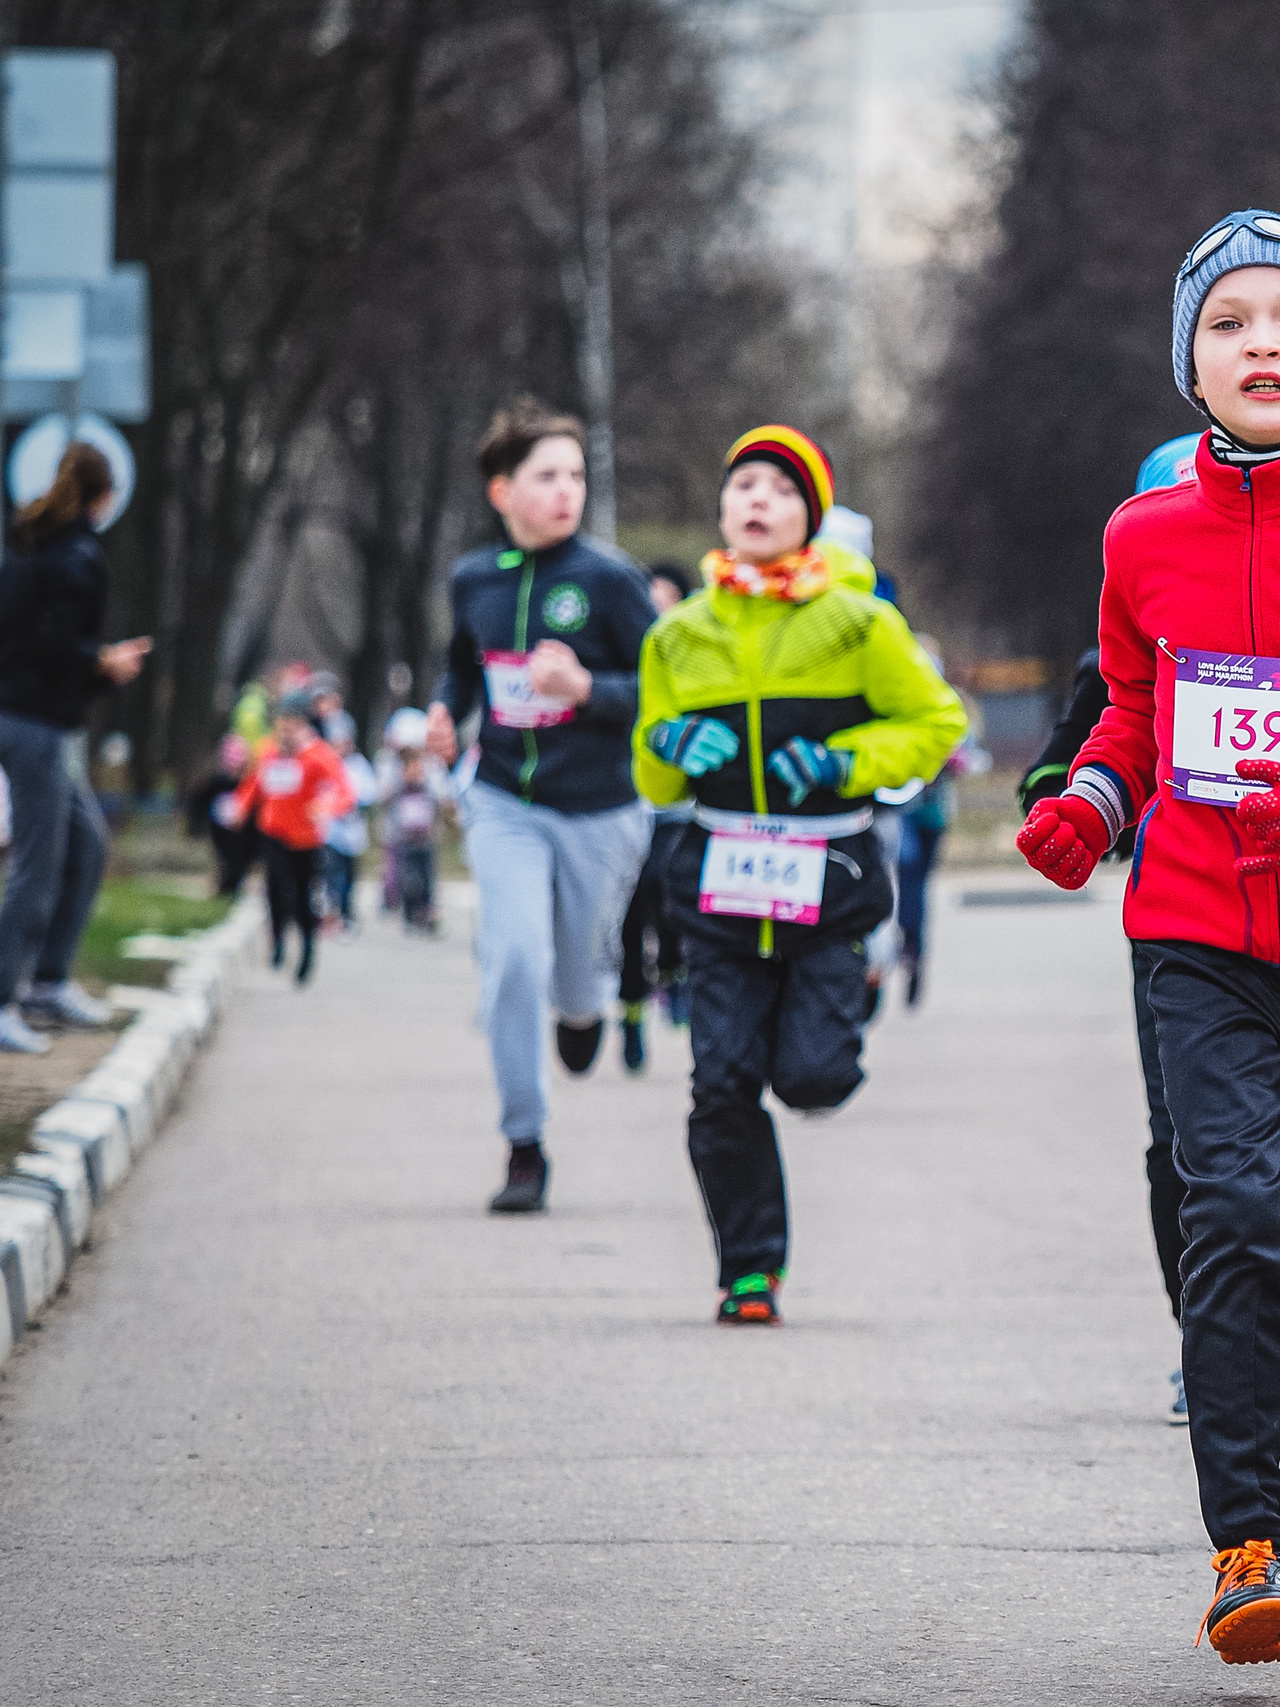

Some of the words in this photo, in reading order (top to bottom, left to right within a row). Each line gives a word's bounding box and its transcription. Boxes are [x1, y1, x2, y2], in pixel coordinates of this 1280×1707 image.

[1198, 661, 1215, 671] LOVE
[1215, 664, 1230, 672] AND
[1230, 665, 1255, 675] SPACE
[1197, 669, 1215, 678] HALF
[1215, 671, 1255, 682] MARATHON
